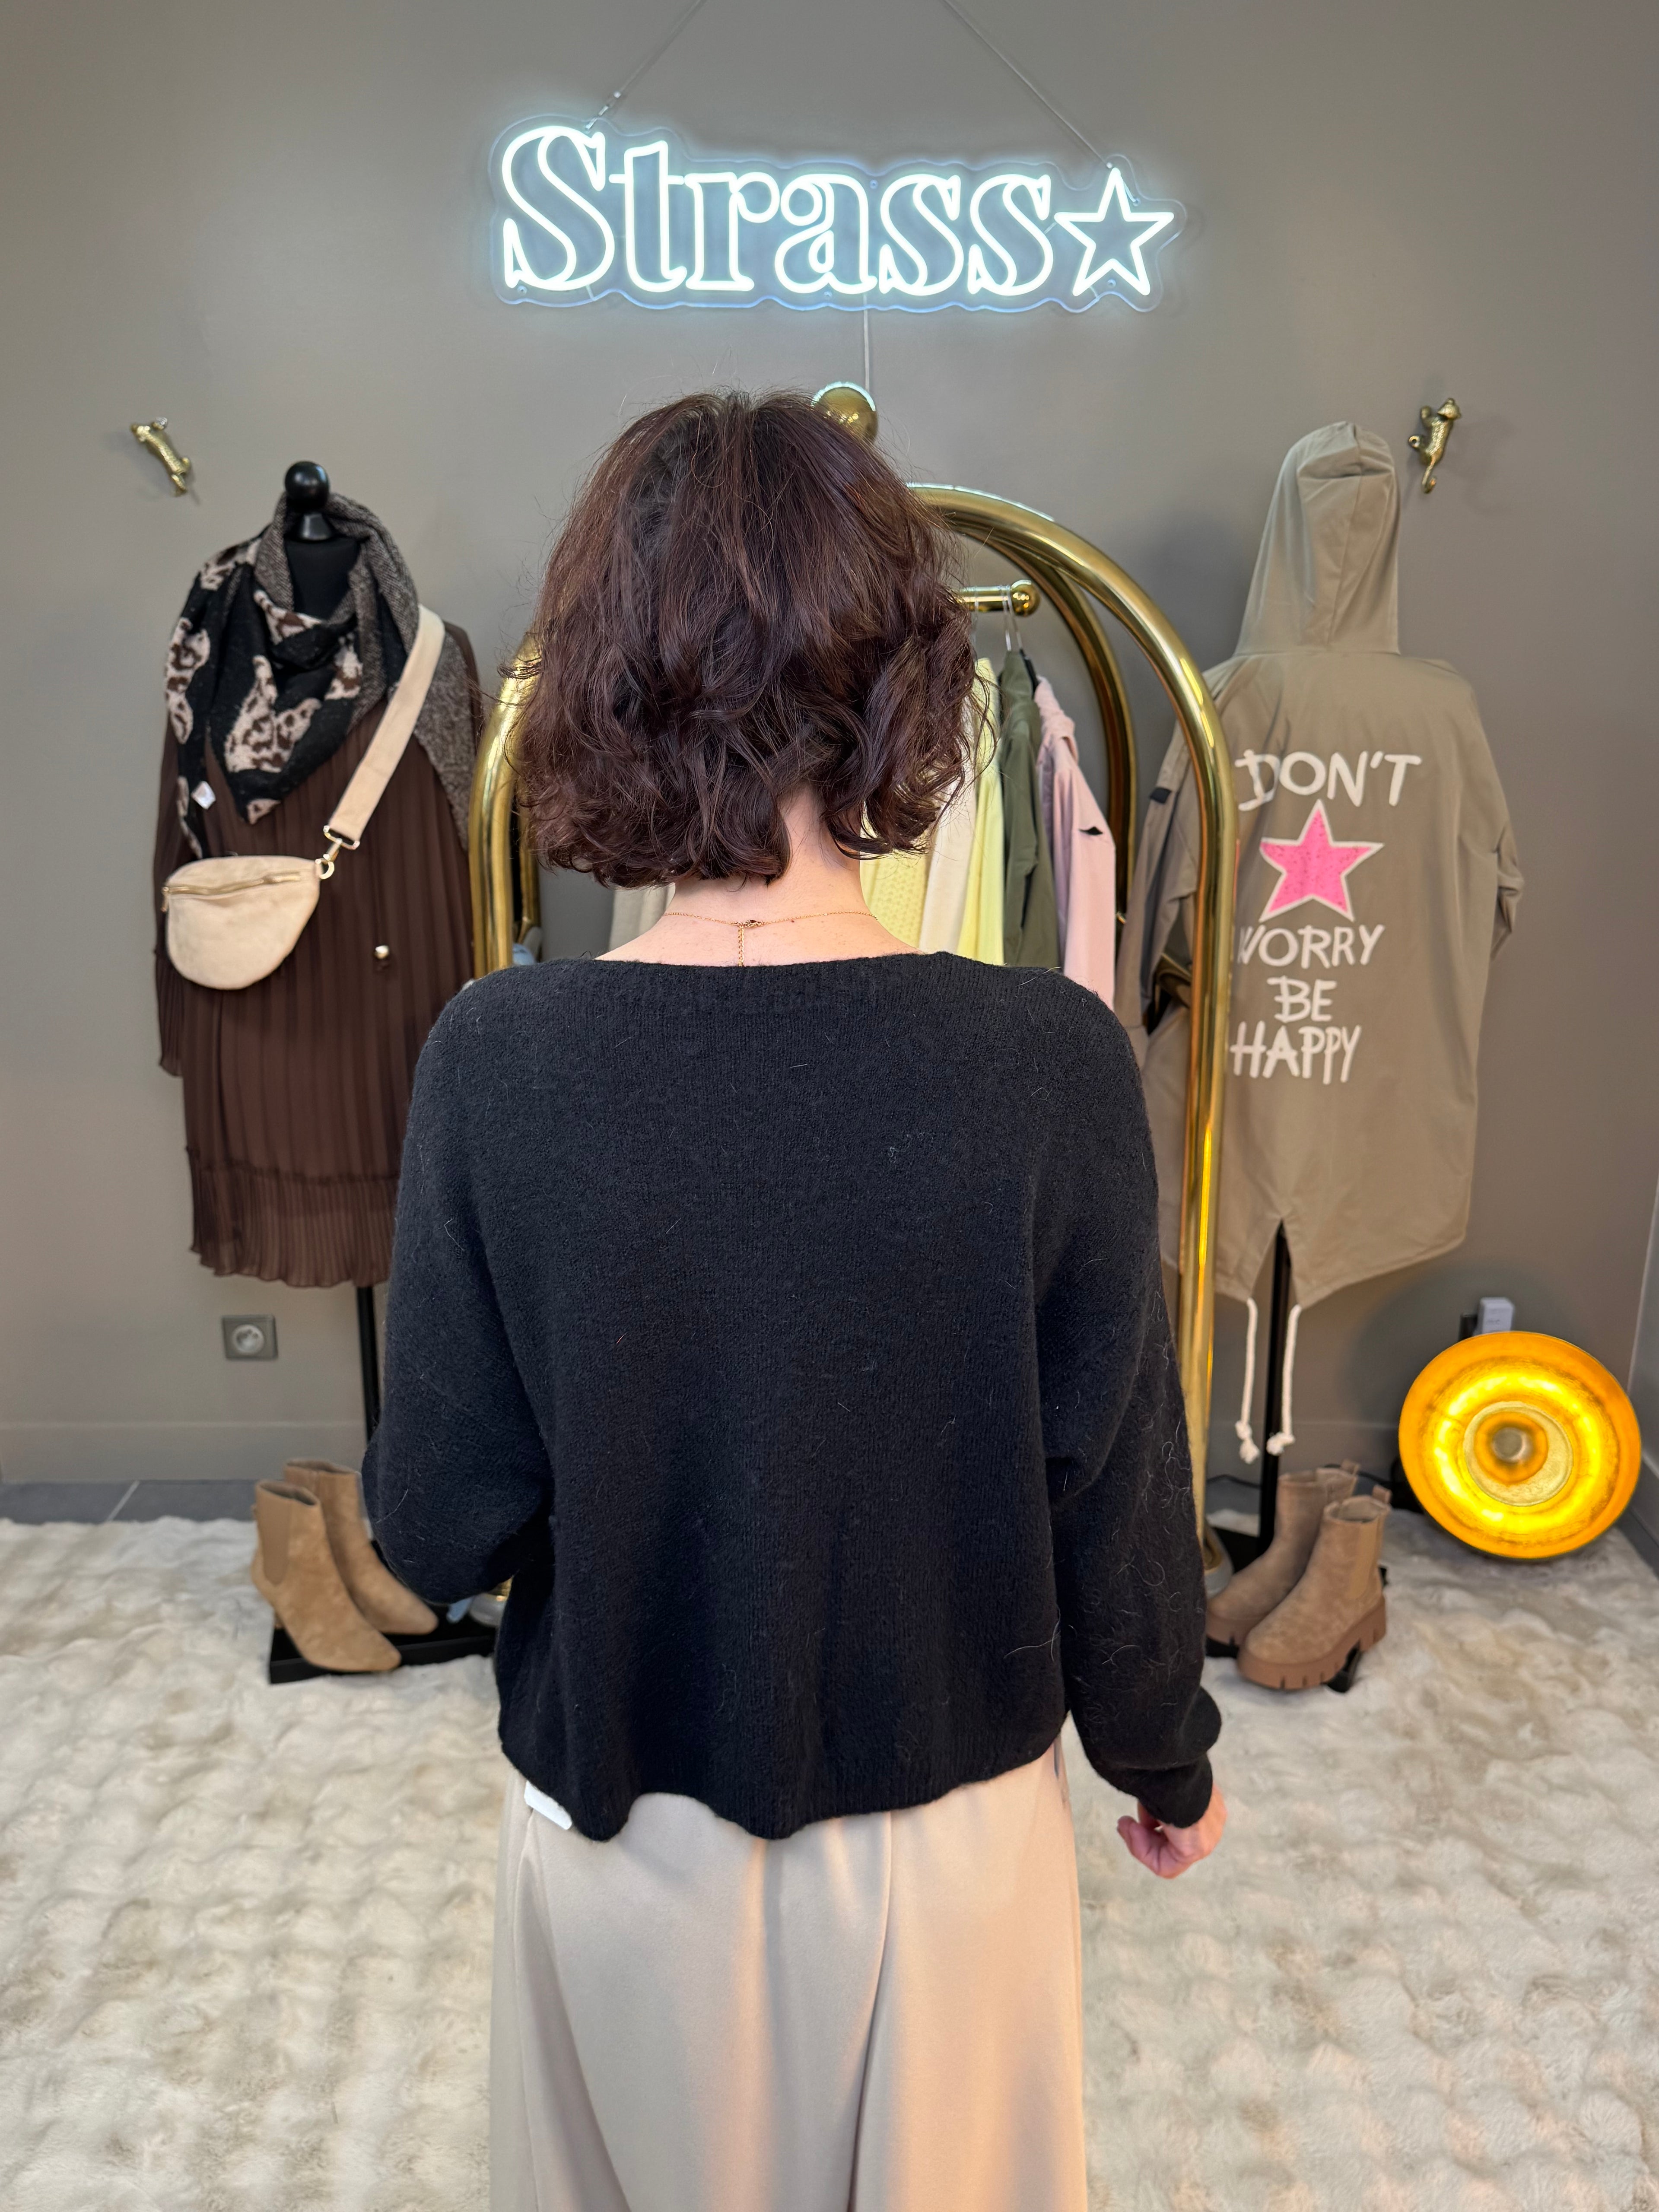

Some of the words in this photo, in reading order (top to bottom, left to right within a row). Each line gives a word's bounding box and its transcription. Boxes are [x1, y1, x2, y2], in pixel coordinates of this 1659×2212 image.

[501, 125, 1054, 295] Strass
[1235, 750, 1422, 811] DON'T
[1267, 976, 1337, 1023] BE
[1230, 1021, 1361, 1084] HAPPY
